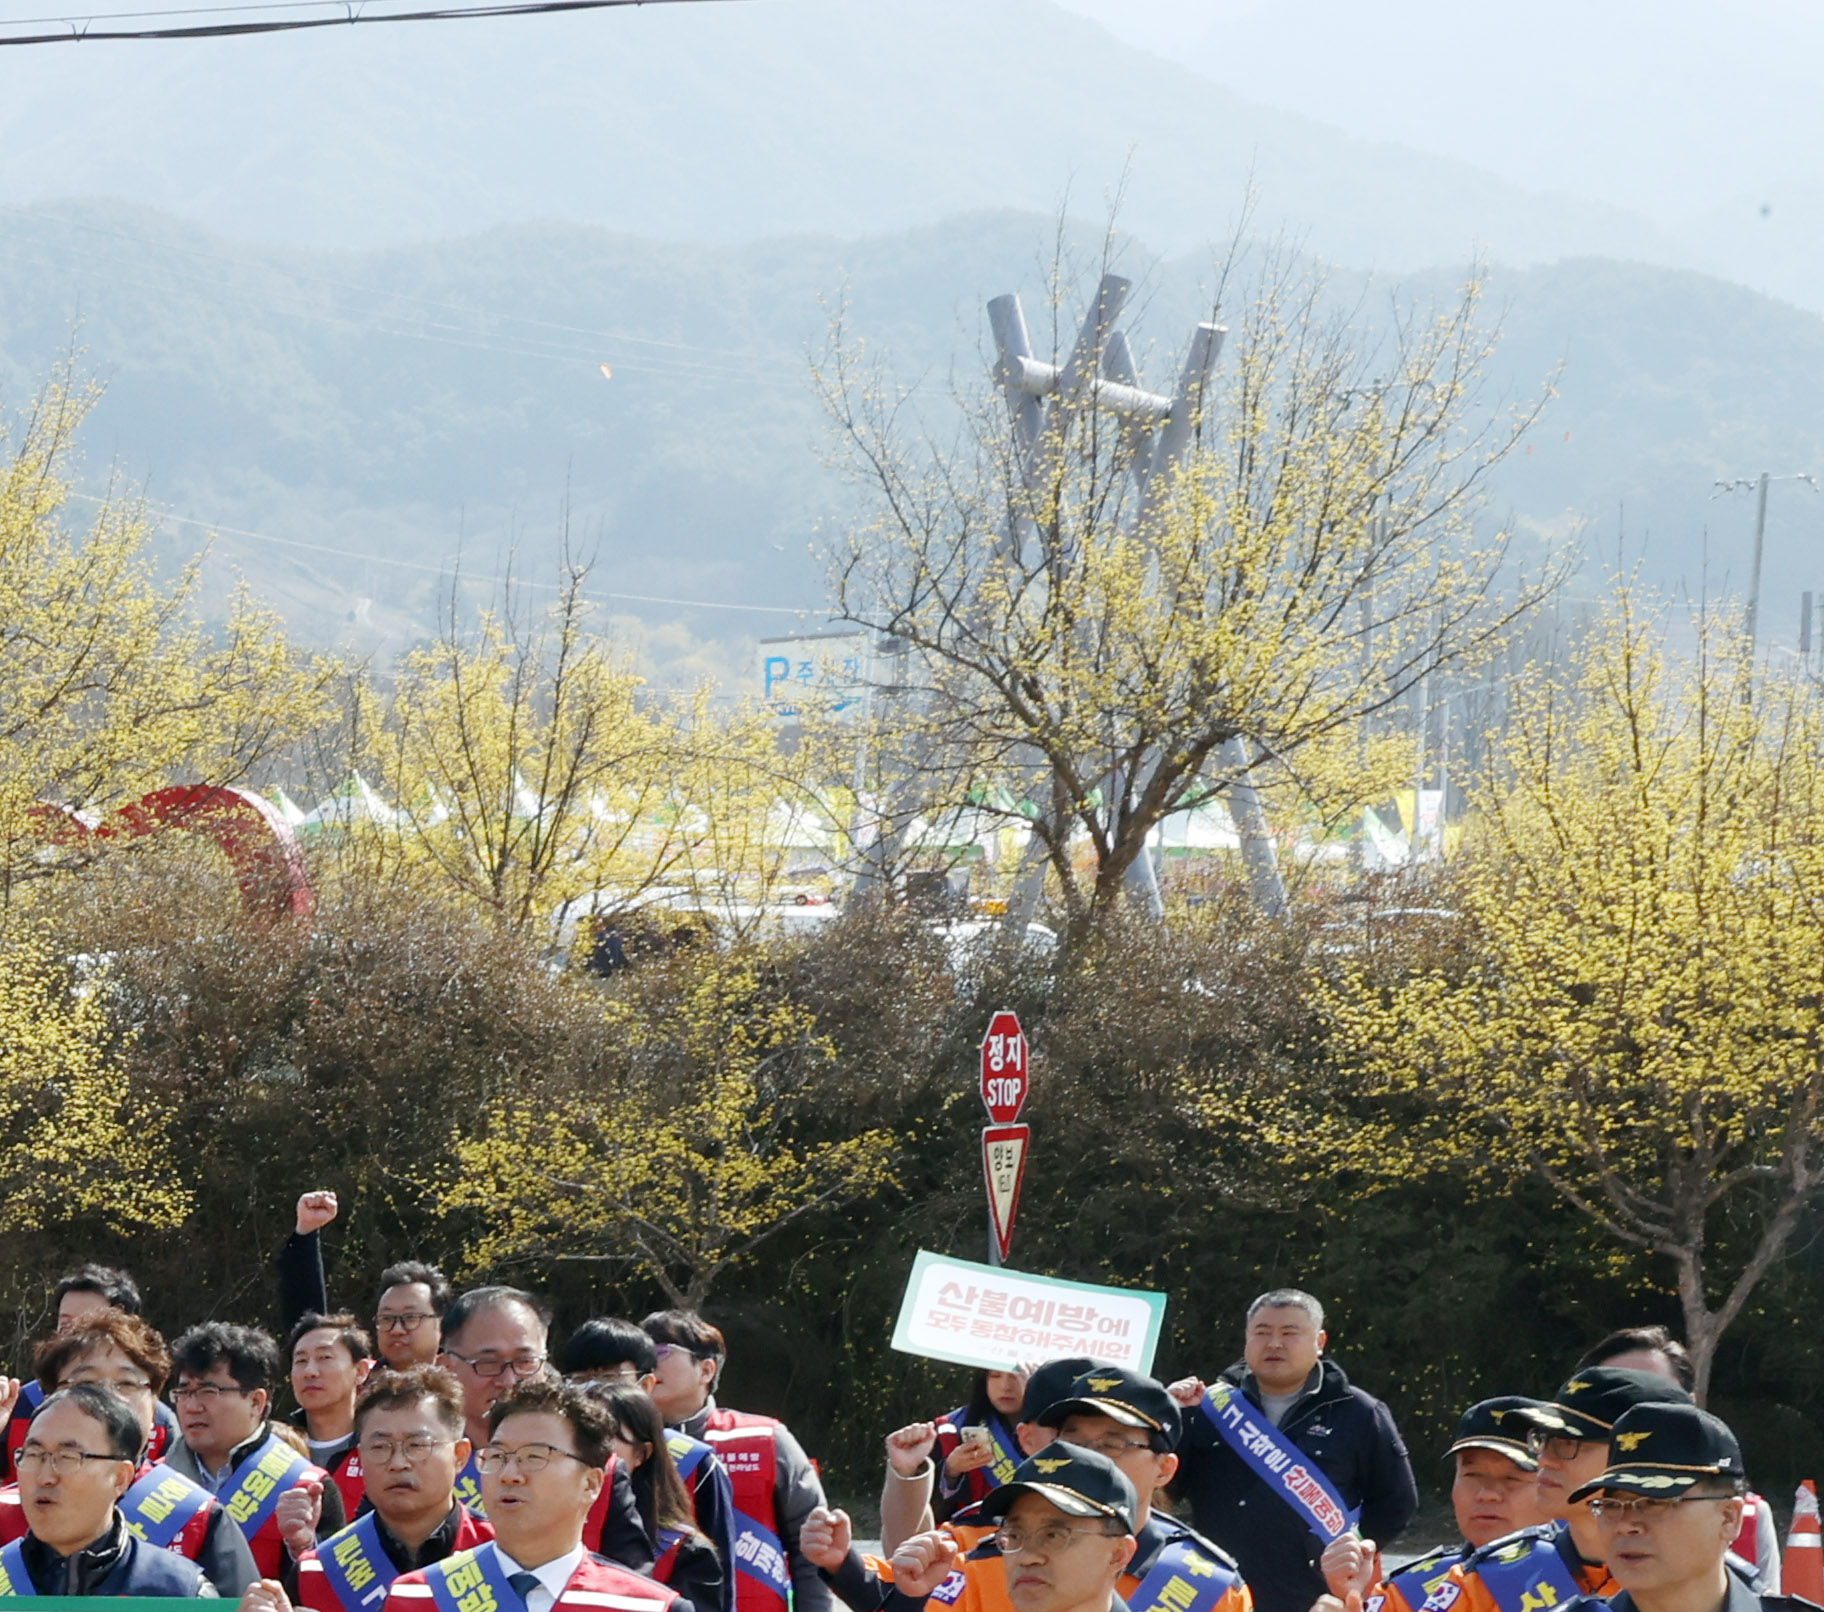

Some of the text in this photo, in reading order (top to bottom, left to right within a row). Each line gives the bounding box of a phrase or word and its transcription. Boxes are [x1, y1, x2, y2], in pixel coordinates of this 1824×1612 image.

[988, 1033, 1022, 1072] 정지
[987, 1078, 1021, 1107] STOP
[925, 1309, 1132, 1361] 모두 동참해주세요!
[937, 1281, 1130, 1338] 산불예방에
[1282, 1463, 1347, 1537] 산불예방
